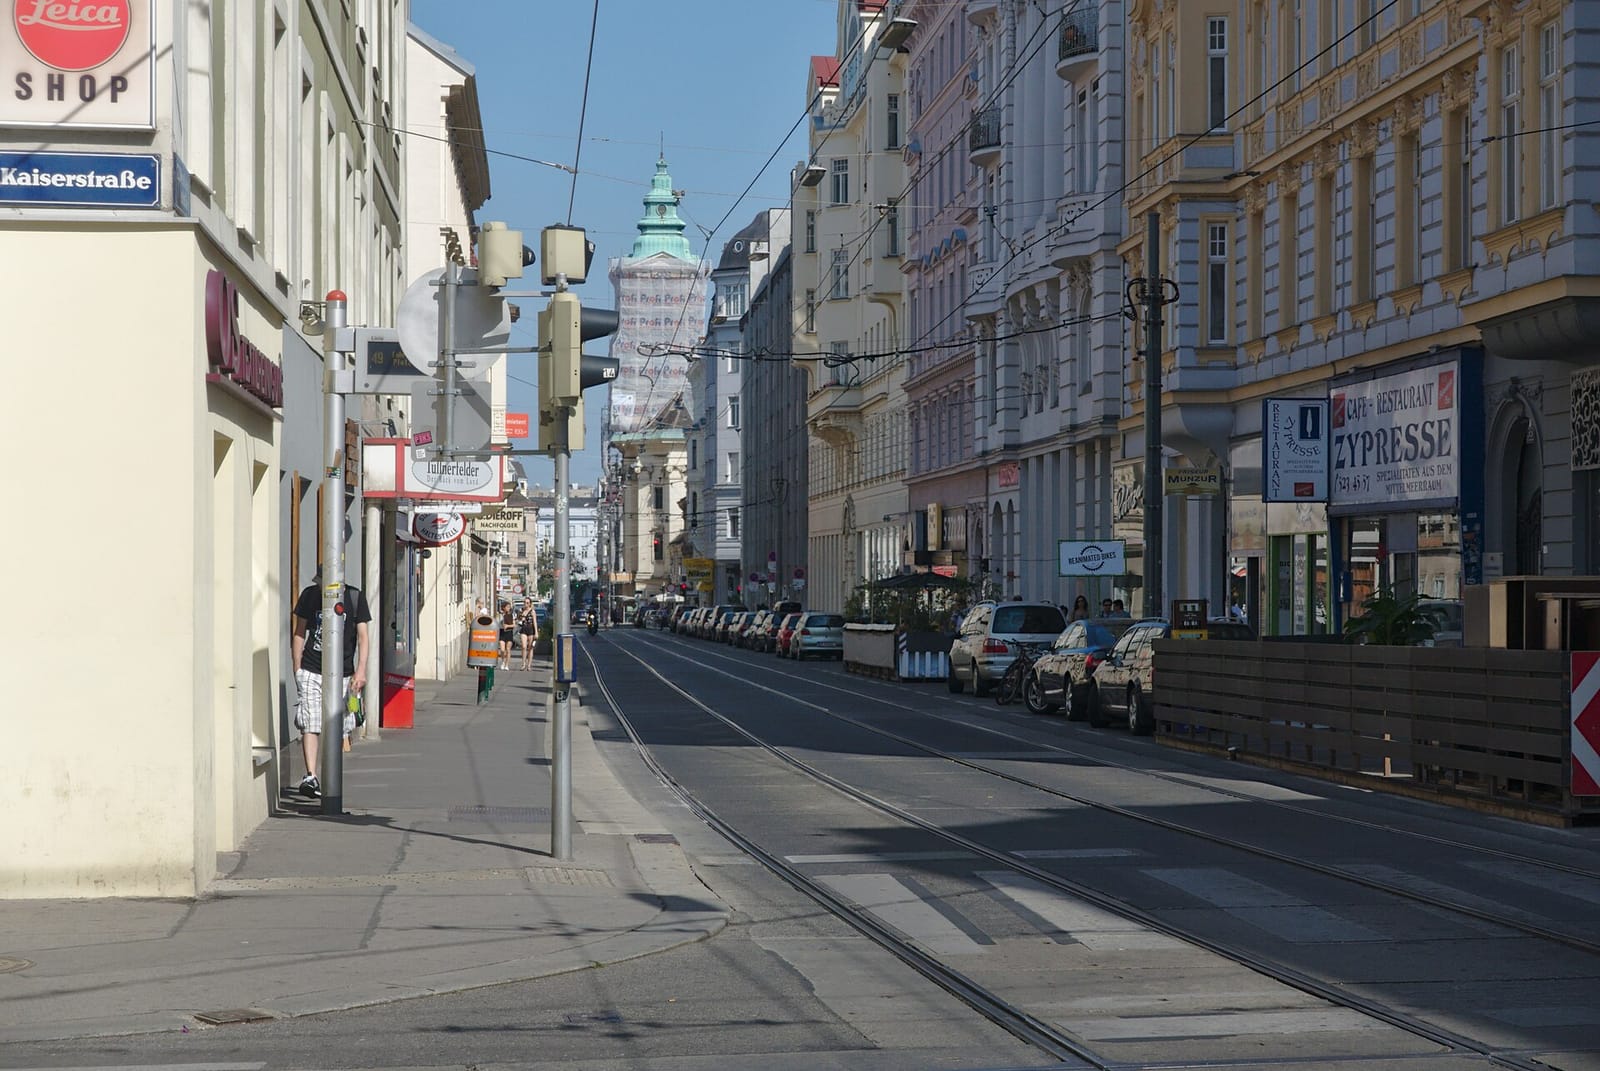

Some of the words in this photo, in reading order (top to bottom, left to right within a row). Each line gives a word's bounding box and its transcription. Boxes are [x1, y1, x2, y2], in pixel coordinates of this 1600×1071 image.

[19, 0, 122, 30] Leica
[15, 72, 128, 103] SHOP
[1, 167, 152, 190] Kaiserstraße
[1377, 382, 1435, 416] RESTAURANT
[1272, 403, 1280, 498] RESTAURANT
[1334, 417, 1452, 471] ZYPRESSE
[1168, 475, 1217, 483] MUNZUR
[420, 527, 458, 540] HALTESTELLE
[1068, 554, 1100, 565] REANIMATED
